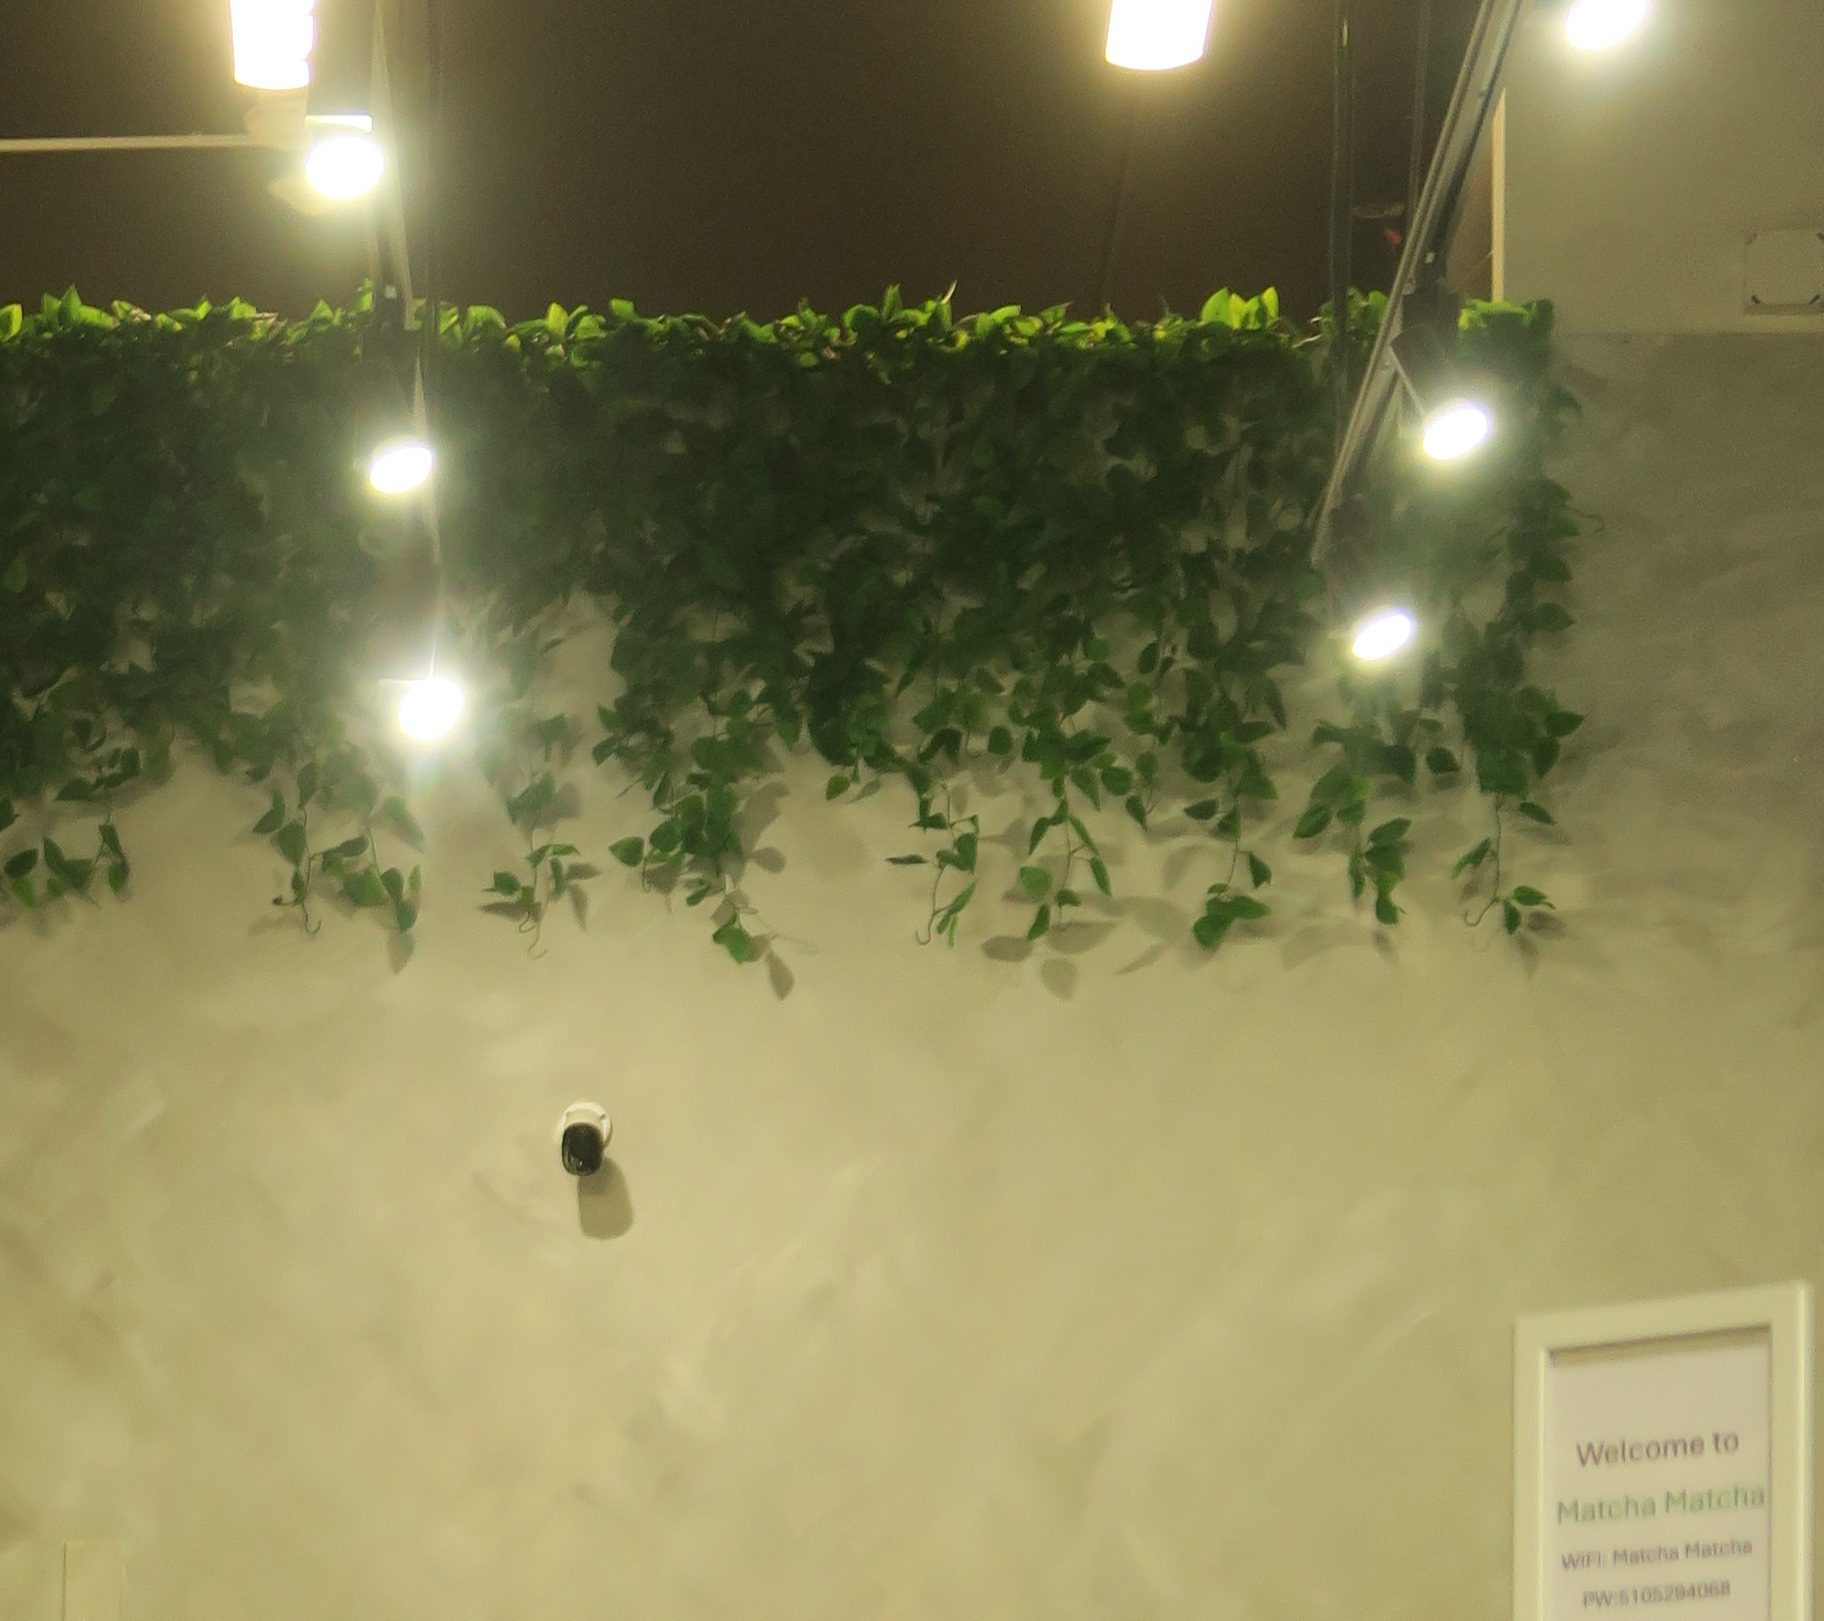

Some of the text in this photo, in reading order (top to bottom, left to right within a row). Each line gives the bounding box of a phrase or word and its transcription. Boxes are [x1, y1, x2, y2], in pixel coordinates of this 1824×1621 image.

[1575, 1431, 1740, 1468] Welcome to
[1557, 1486, 1765, 1523] Matcha Matcha
